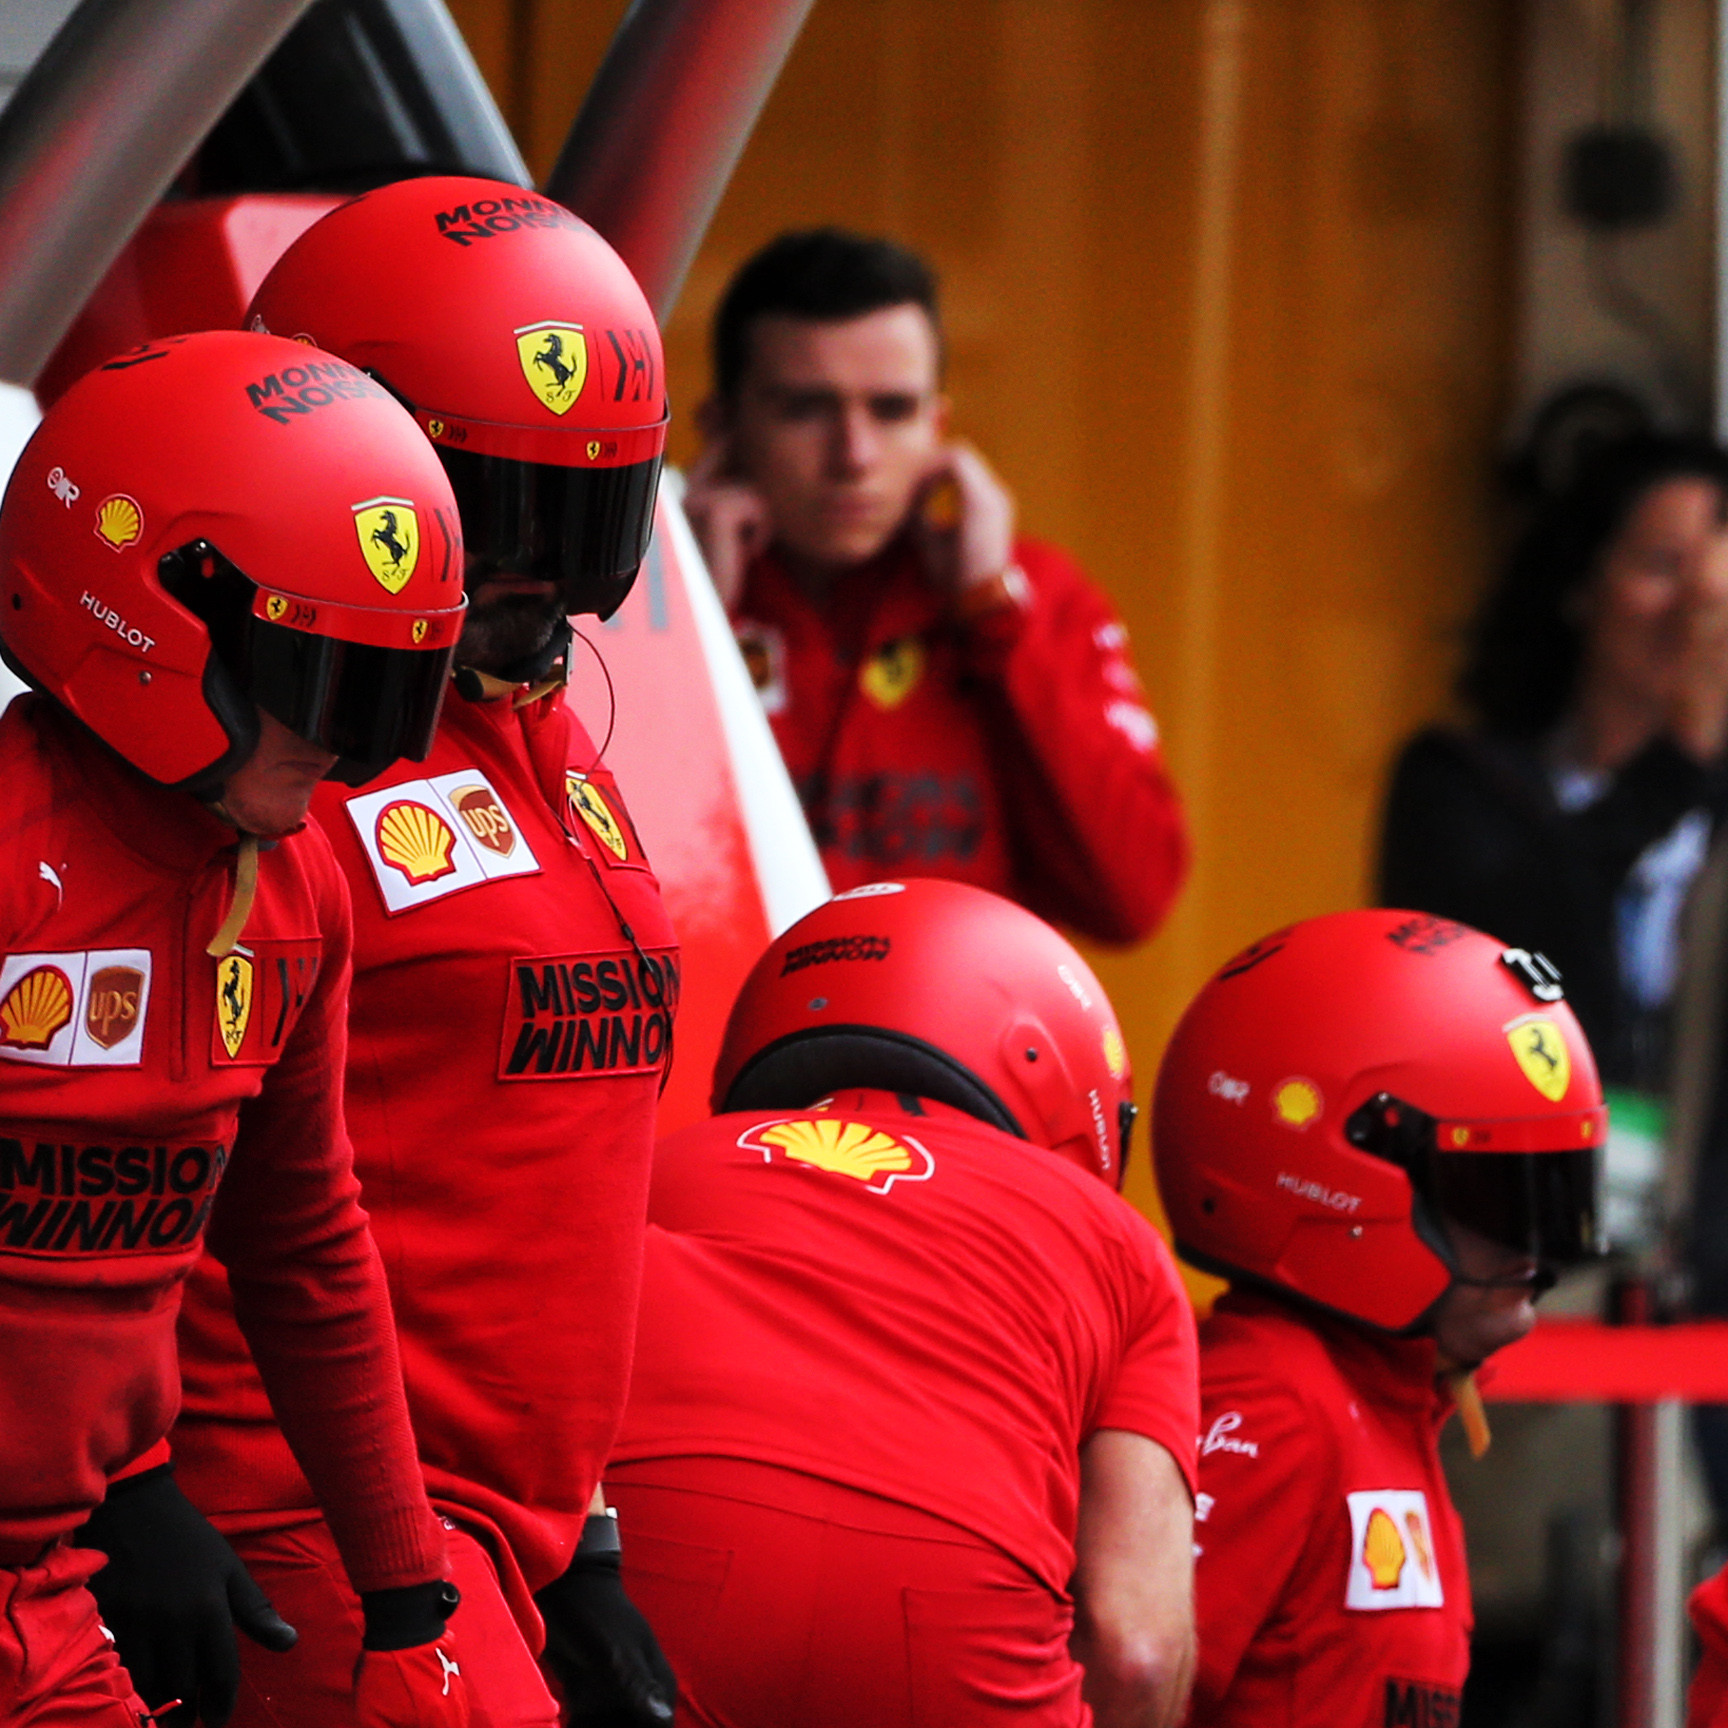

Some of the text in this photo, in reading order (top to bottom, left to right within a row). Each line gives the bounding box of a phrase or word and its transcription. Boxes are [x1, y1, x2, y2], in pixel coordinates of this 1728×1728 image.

[80, 589, 155, 654] HUBLOT
[462, 804, 509, 847] ups
[90, 990, 138, 1036] ups
[1275, 1171, 1363, 1214] HUBLOT
